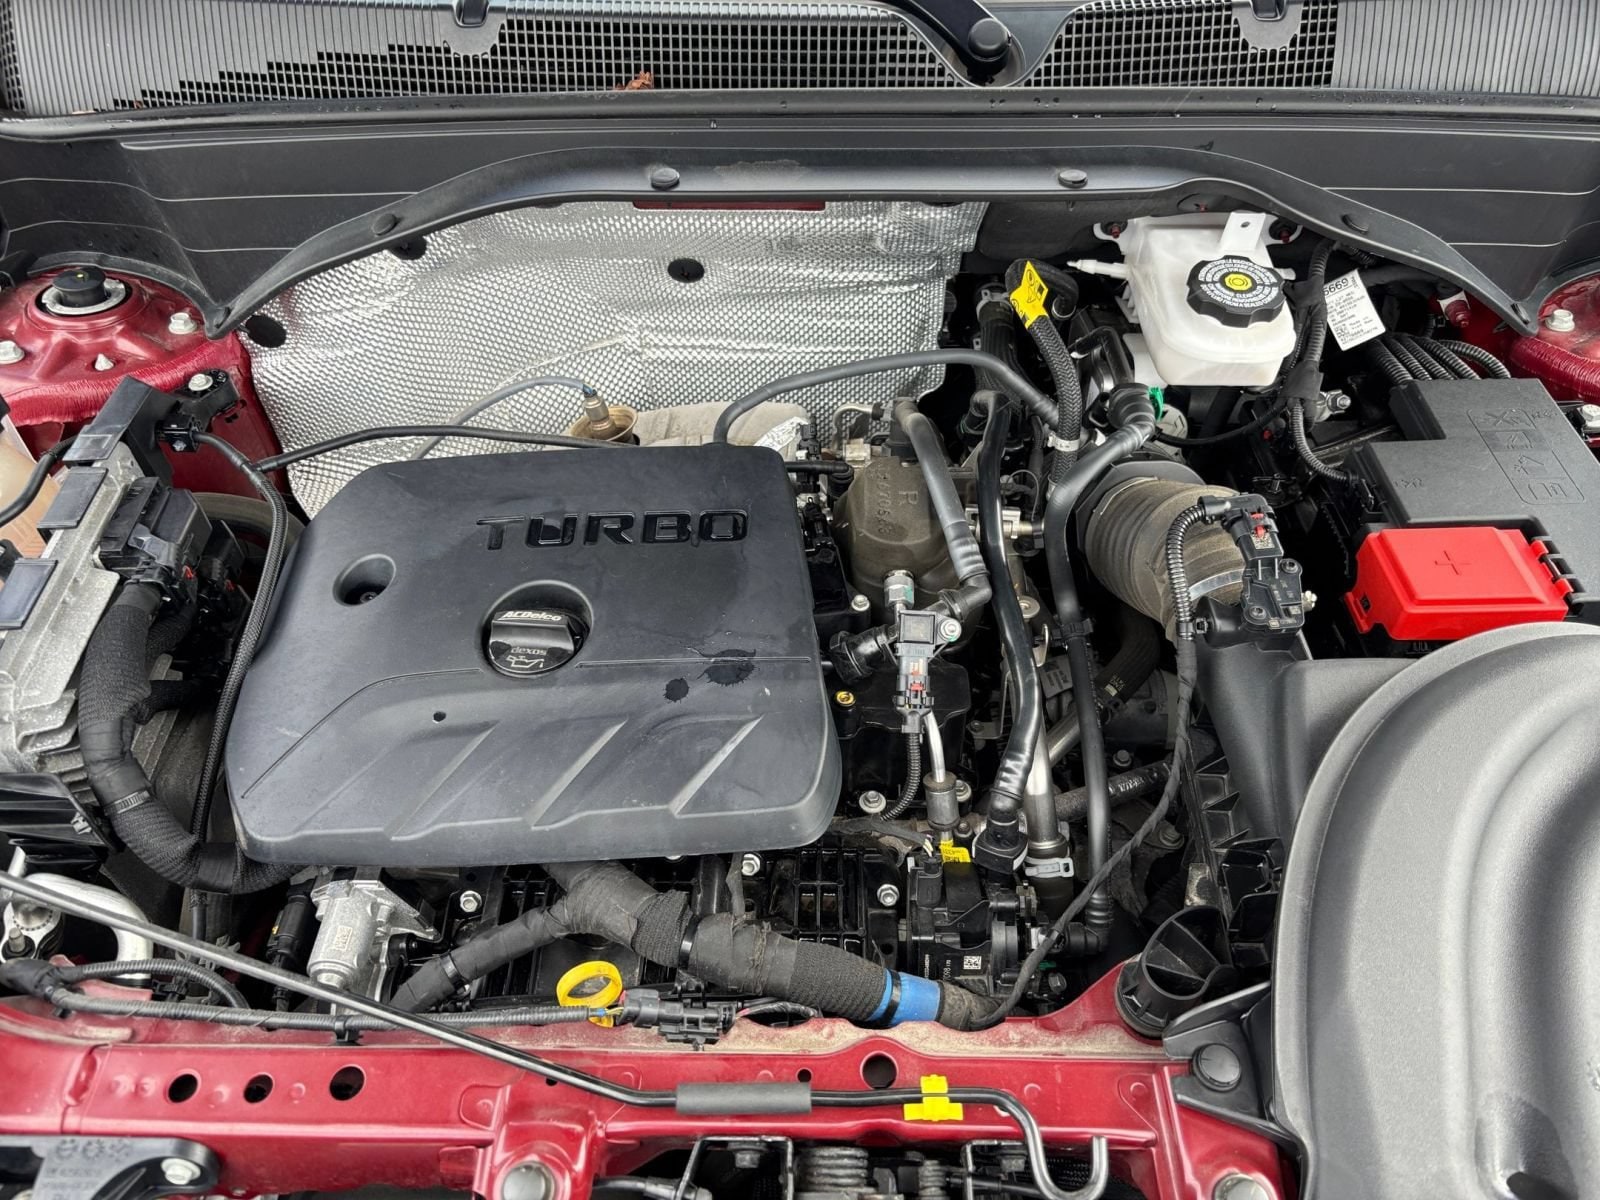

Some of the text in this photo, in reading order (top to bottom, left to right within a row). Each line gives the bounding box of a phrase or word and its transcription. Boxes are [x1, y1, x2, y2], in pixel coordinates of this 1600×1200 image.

[476, 509, 749, 551] TURBO
[502, 610, 562, 621] ACDelco
[510, 646, 547, 656] dexos
